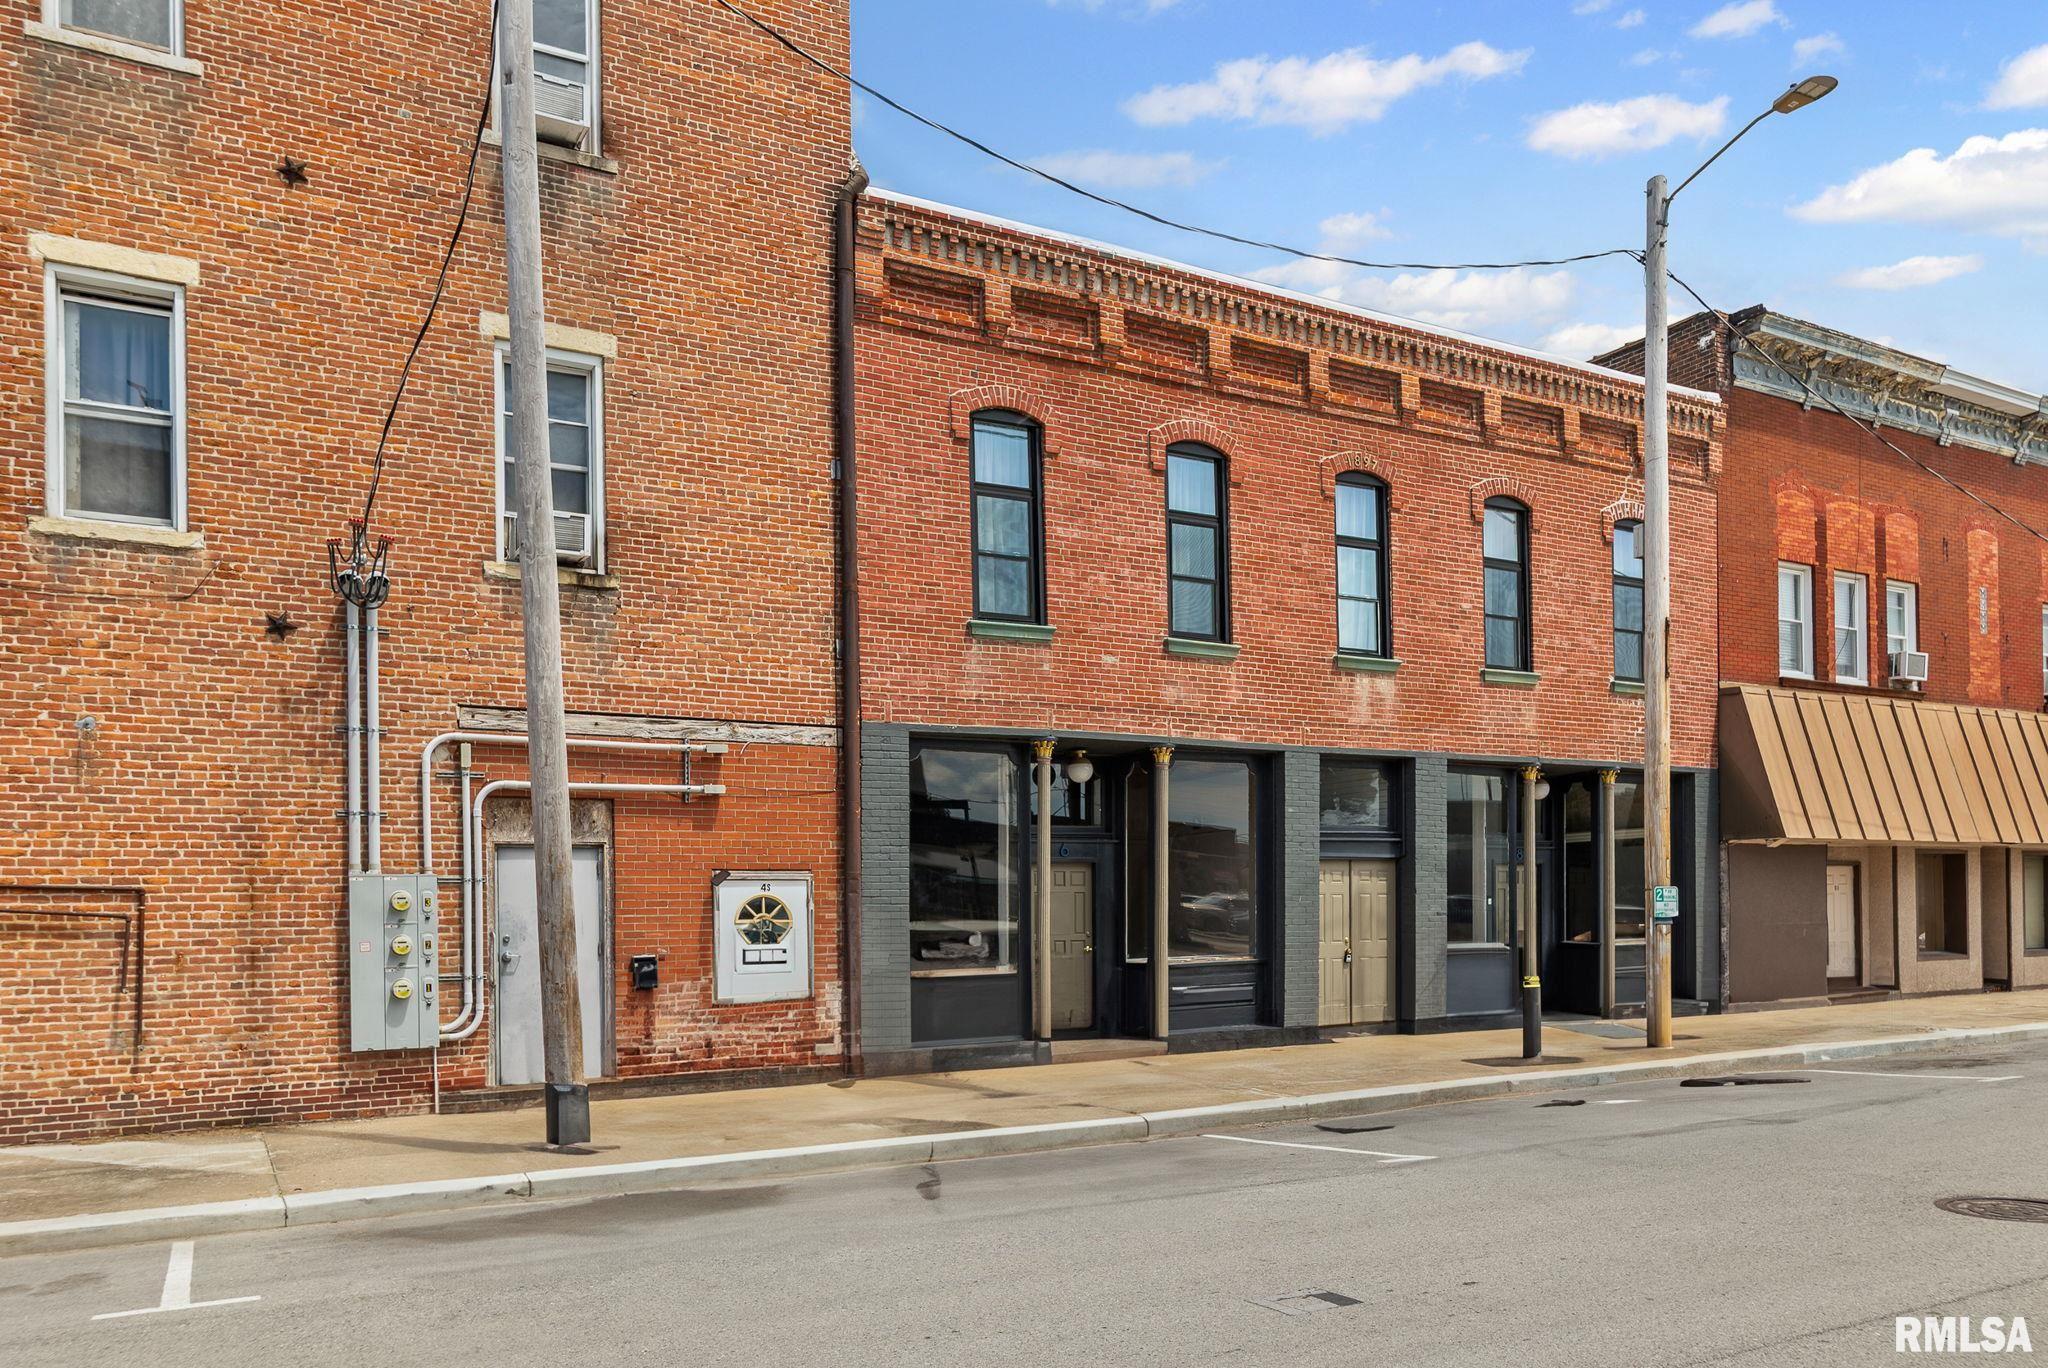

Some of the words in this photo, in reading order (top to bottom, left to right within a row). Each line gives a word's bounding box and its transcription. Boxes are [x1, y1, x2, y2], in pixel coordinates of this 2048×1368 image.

[1346, 453, 1378, 469] 1897
[1059, 842, 1069, 857] 6
[1516, 848, 1523, 860] 8
[1656, 889, 1663, 901] 2
[425, 898, 431, 907] 3
[426, 941, 431, 949] 2
